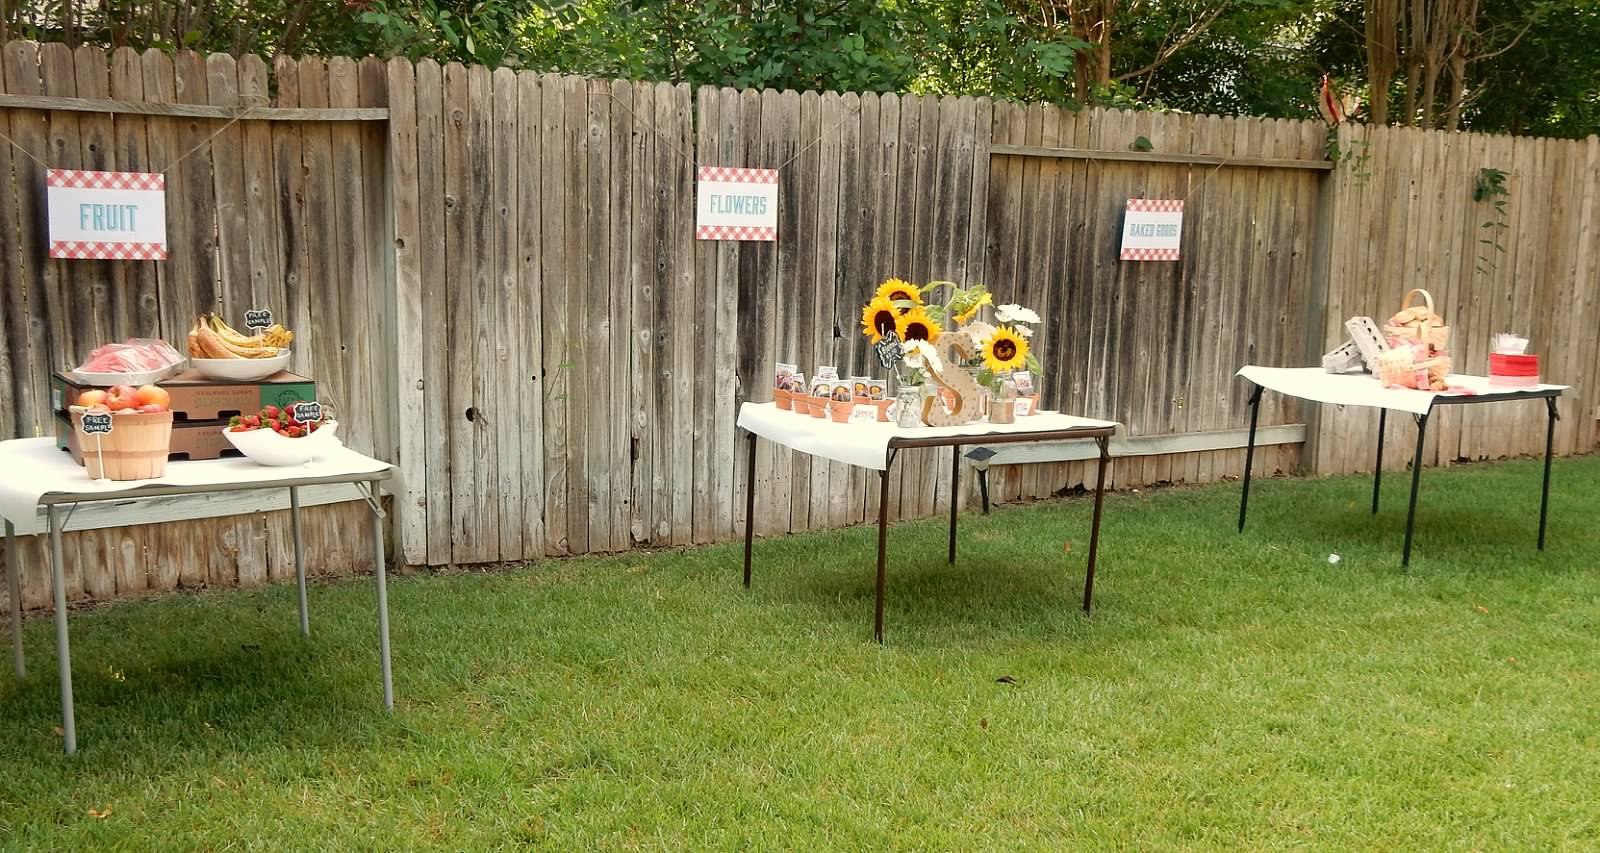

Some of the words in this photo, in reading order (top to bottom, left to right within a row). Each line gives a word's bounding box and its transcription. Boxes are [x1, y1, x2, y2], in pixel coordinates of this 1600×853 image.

[710, 194, 767, 215] FLOWERS
[80, 203, 138, 232] FRUIT
[1130, 223, 1154, 237] BAKED
[1156, 223, 1178, 237] GOODS
[86, 416, 109, 424] FREE
